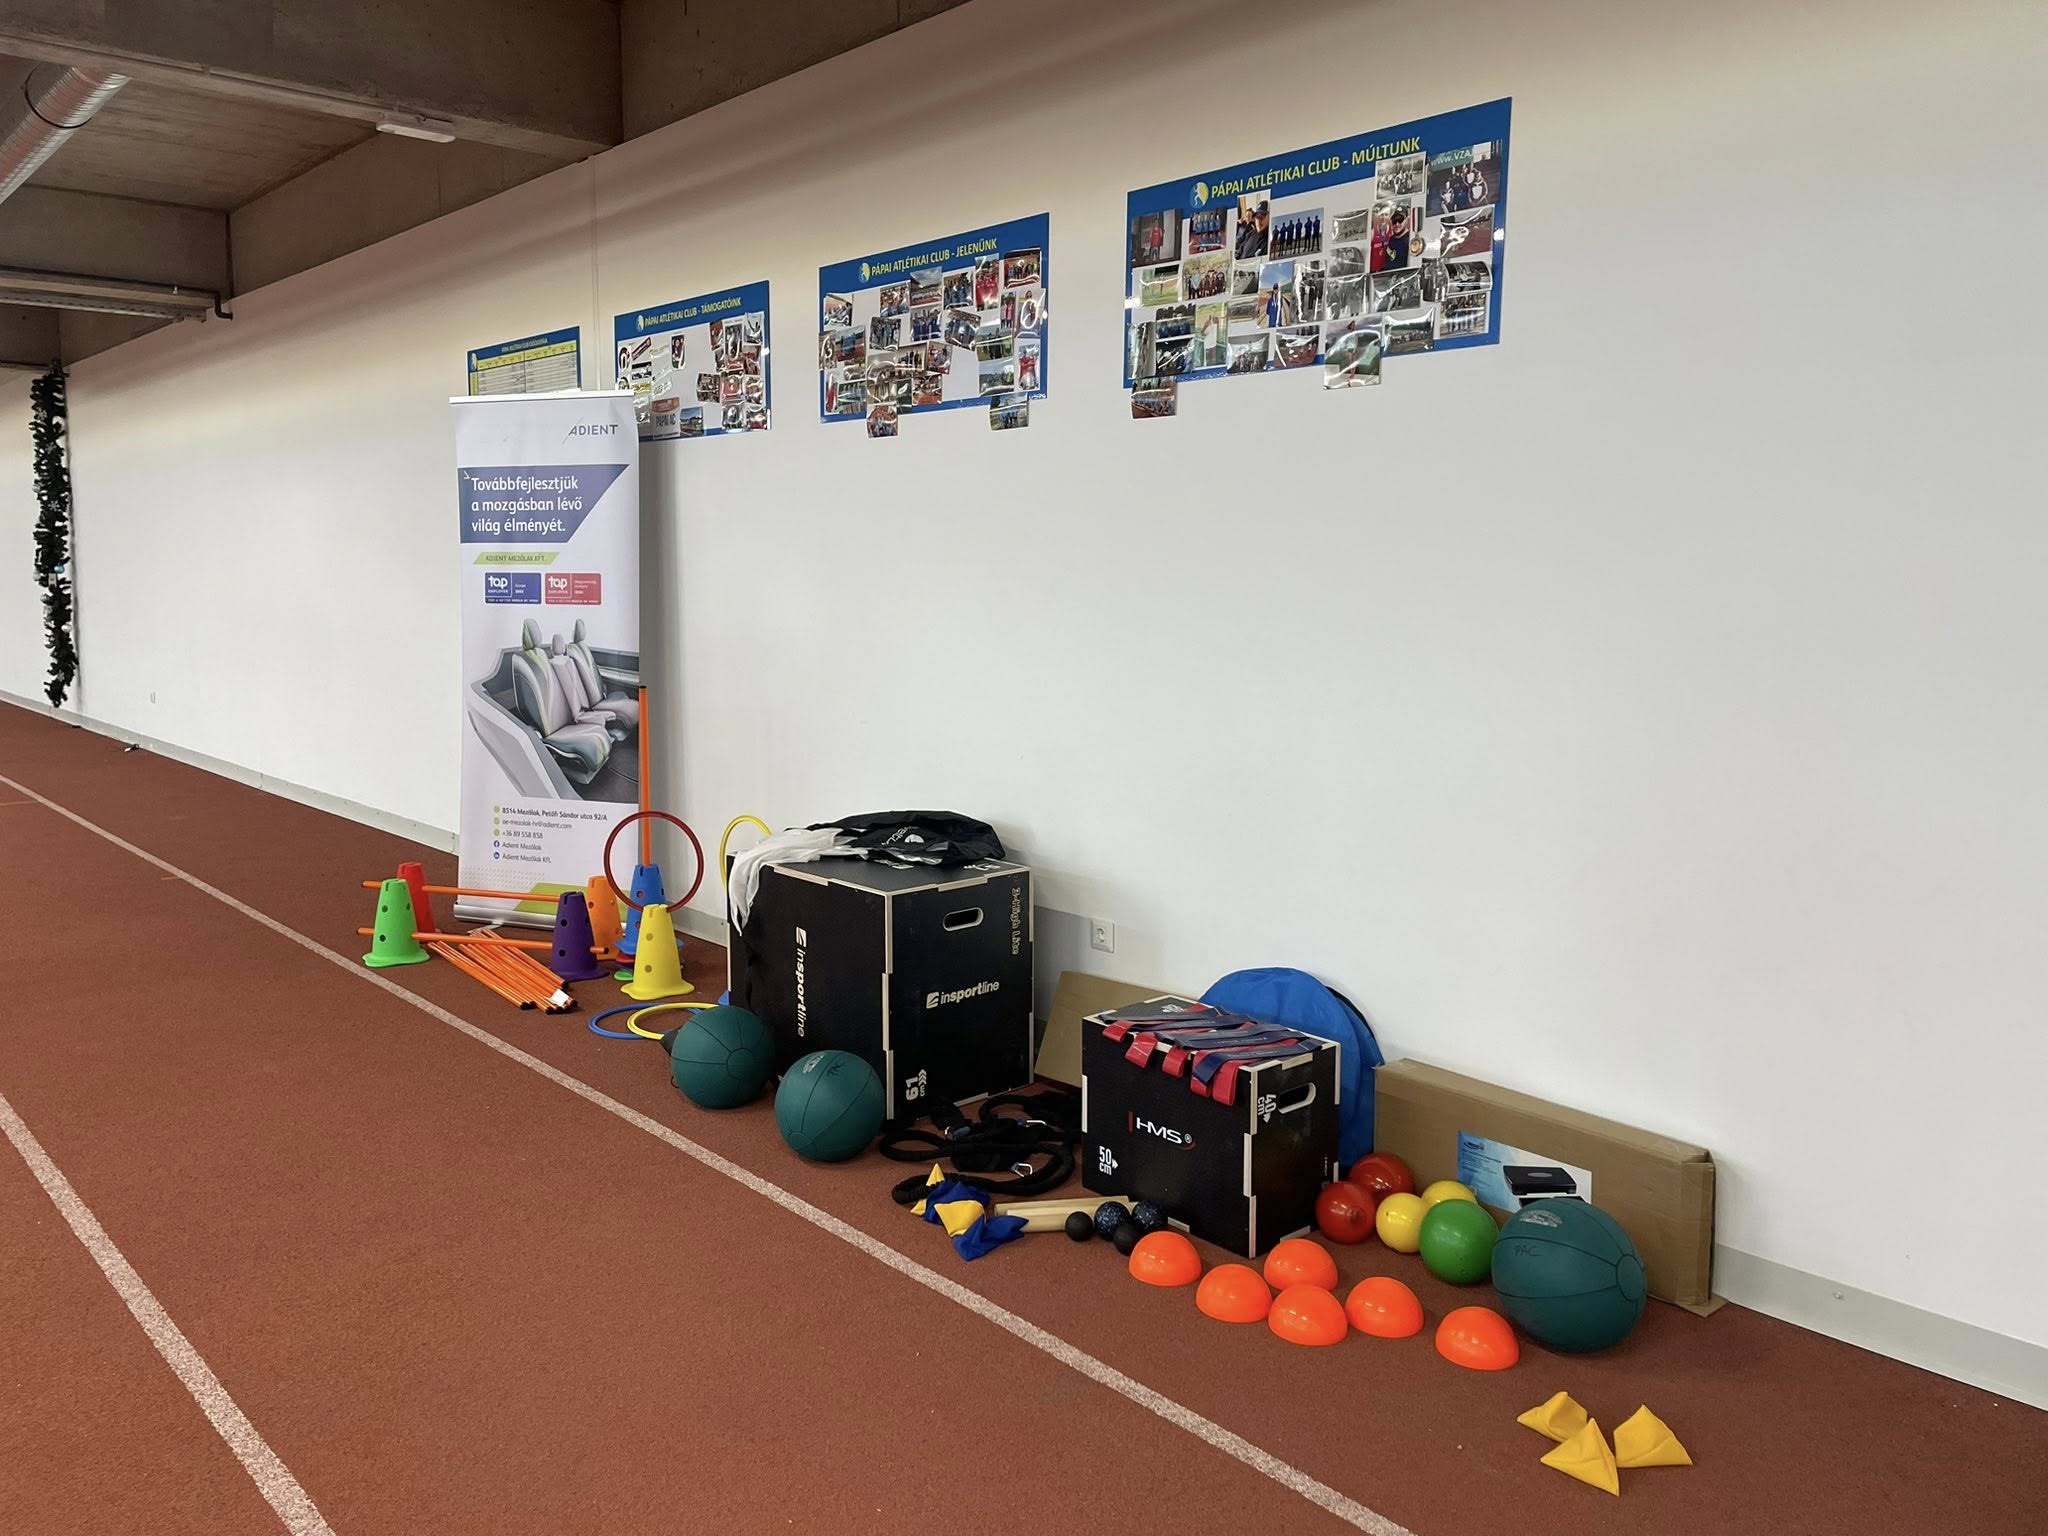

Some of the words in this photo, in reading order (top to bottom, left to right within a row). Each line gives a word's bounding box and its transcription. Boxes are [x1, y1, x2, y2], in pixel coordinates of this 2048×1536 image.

[1211, 178, 1243, 198] PÁPAI
[1246, 164, 1305, 189] ATLÉTIKAI
[1308, 156, 1340, 176] CLUB
[1351, 136, 1421, 166] MÚLTUNK
[871, 260, 892, 277] PÁPAI
[893, 255, 929, 272] ATLÉTIKAI
[930, 249, 950, 263] CLUB
[644, 315, 659, 327] PÁPAI
[683, 307, 698, 319] CLUB
[568, 424, 619, 436] ADIENT
[471, 475, 578, 494] Továbbfejlesztjük
[471, 500, 480, 511] a
[483, 498, 554, 514] mozgásban
[557, 496, 583, 511] lévő
[471, 518, 501, 535] világ
[504, 518, 566, 535] élményét.
[502, 807, 516, 815] 8514
[593, 813, 608, 821] 92/A
[796, 947, 807, 1038] insportline
[940, 981, 1000, 1005] insportline
[905, 1077, 919, 1101] 61
[1257, 1096, 1265, 1116] cm
[1264, 1093, 1277, 1113] 40
[1136, 1116, 1183, 1145] HMS
[1099, 1145, 1112, 1165] 50
[1099, 1162, 1112, 1176] cm
